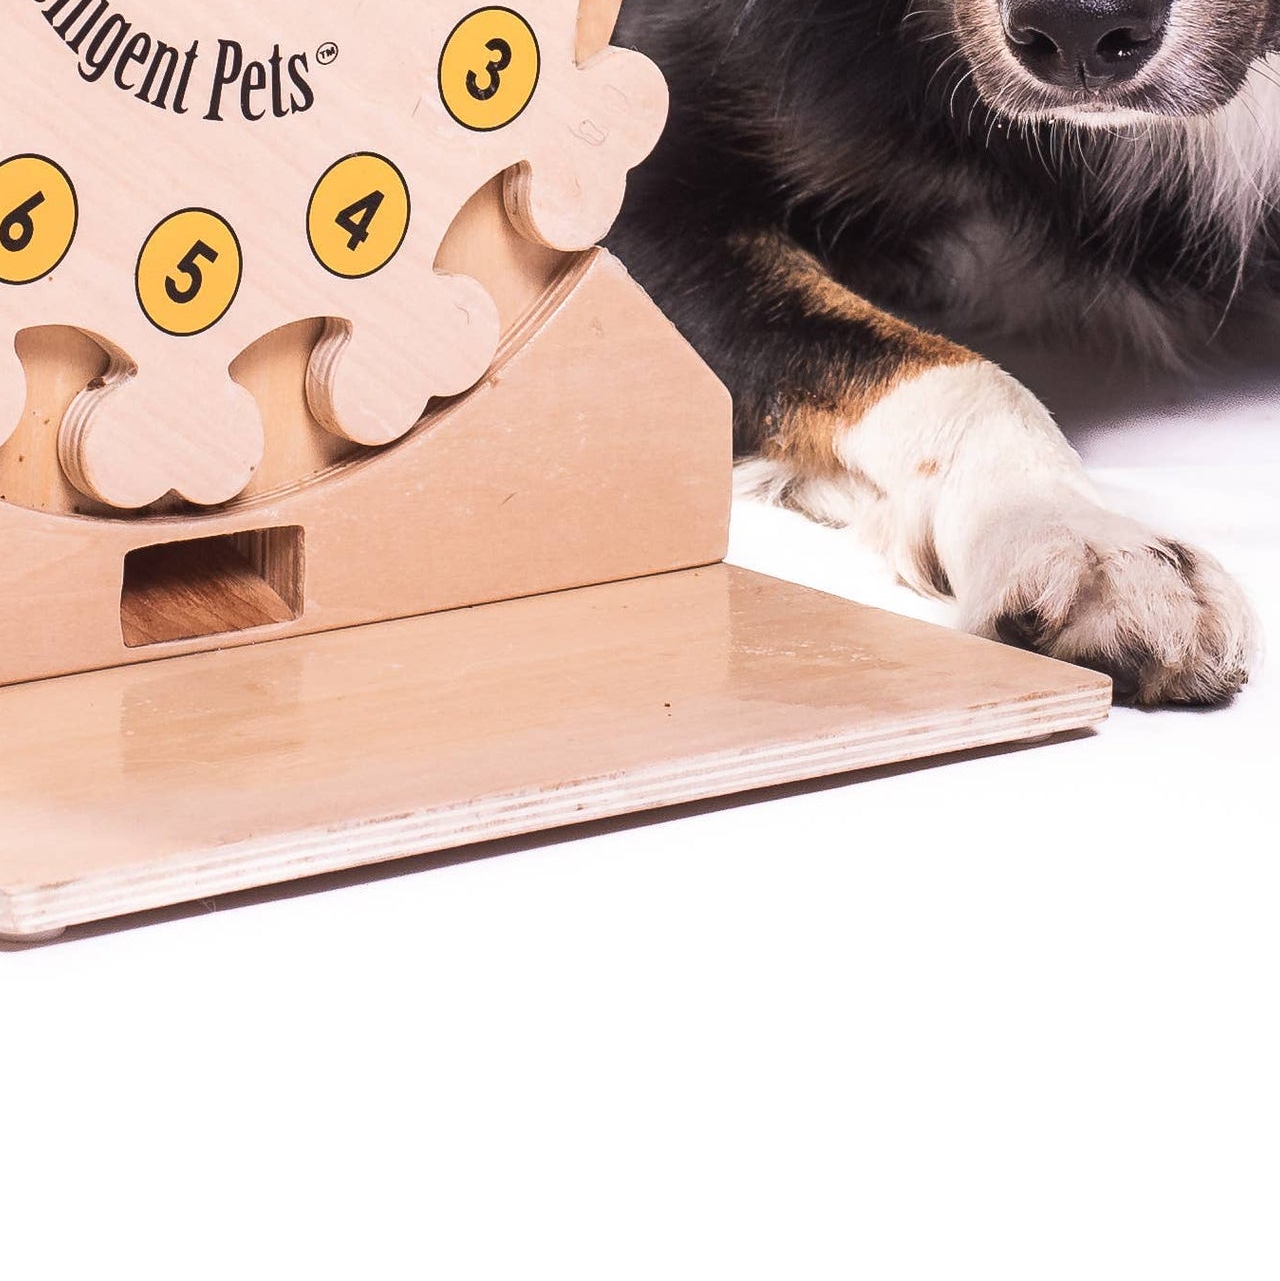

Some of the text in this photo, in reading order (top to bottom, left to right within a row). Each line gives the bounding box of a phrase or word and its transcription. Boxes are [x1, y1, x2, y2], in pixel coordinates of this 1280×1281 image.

[202, 39, 314, 122] Pets
[465, 38, 512, 101] 3
[334, 190, 385, 252] 4
[164, 239, 219, 304] 5
